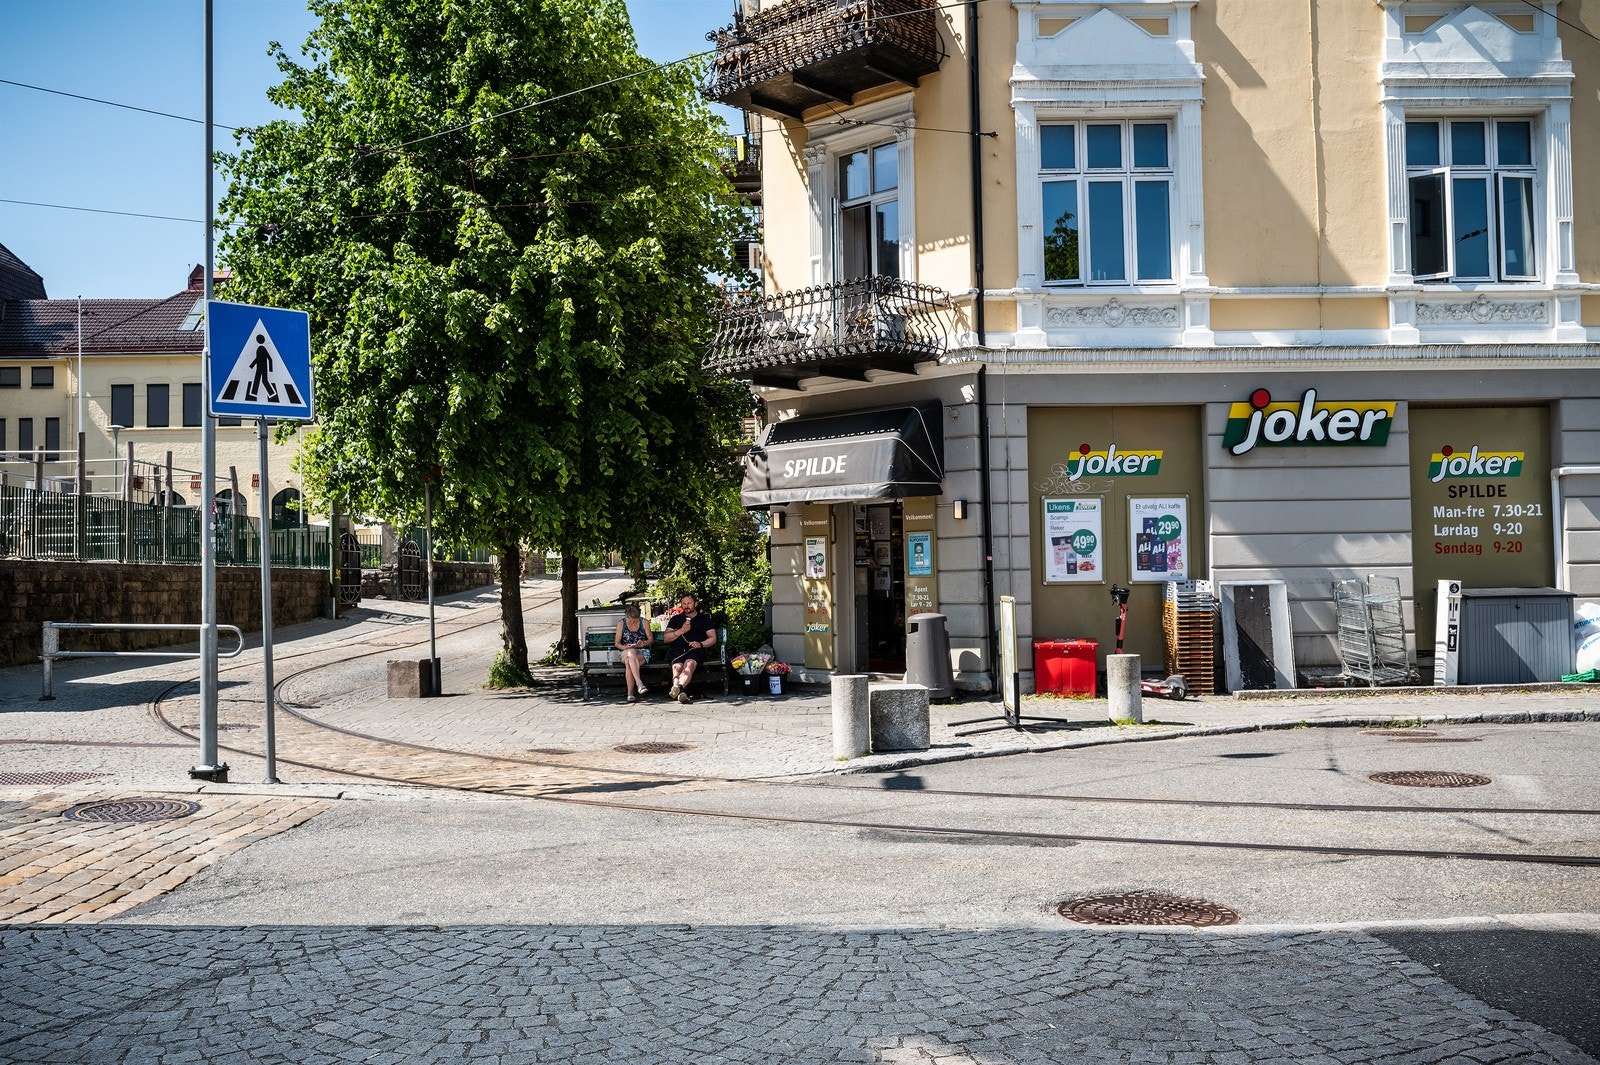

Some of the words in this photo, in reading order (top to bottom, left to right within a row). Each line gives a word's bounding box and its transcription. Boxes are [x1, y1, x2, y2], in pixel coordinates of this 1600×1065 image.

[1229, 388, 1388, 456] joker
[783, 454, 848, 479] SPILDE
[1068, 443, 1157, 481] joker
[1431, 445, 1518, 483] joker
[1448, 484, 1507, 498] SPILDE
[1049, 503, 1071, 511] Ukens
[1142, 503, 1157, 511] utvalg
[1433, 505, 1485, 519] Man-fre
[1493, 504, 1543, 517] 7.30-21
[1434, 523, 1479, 538] Lørdag
[1493, 522, 1523, 535] 9-20
[1434, 541, 1482, 556] Søndag
[1493, 540, 1523, 554] 9-20
[806, 621, 829, 633] joker
